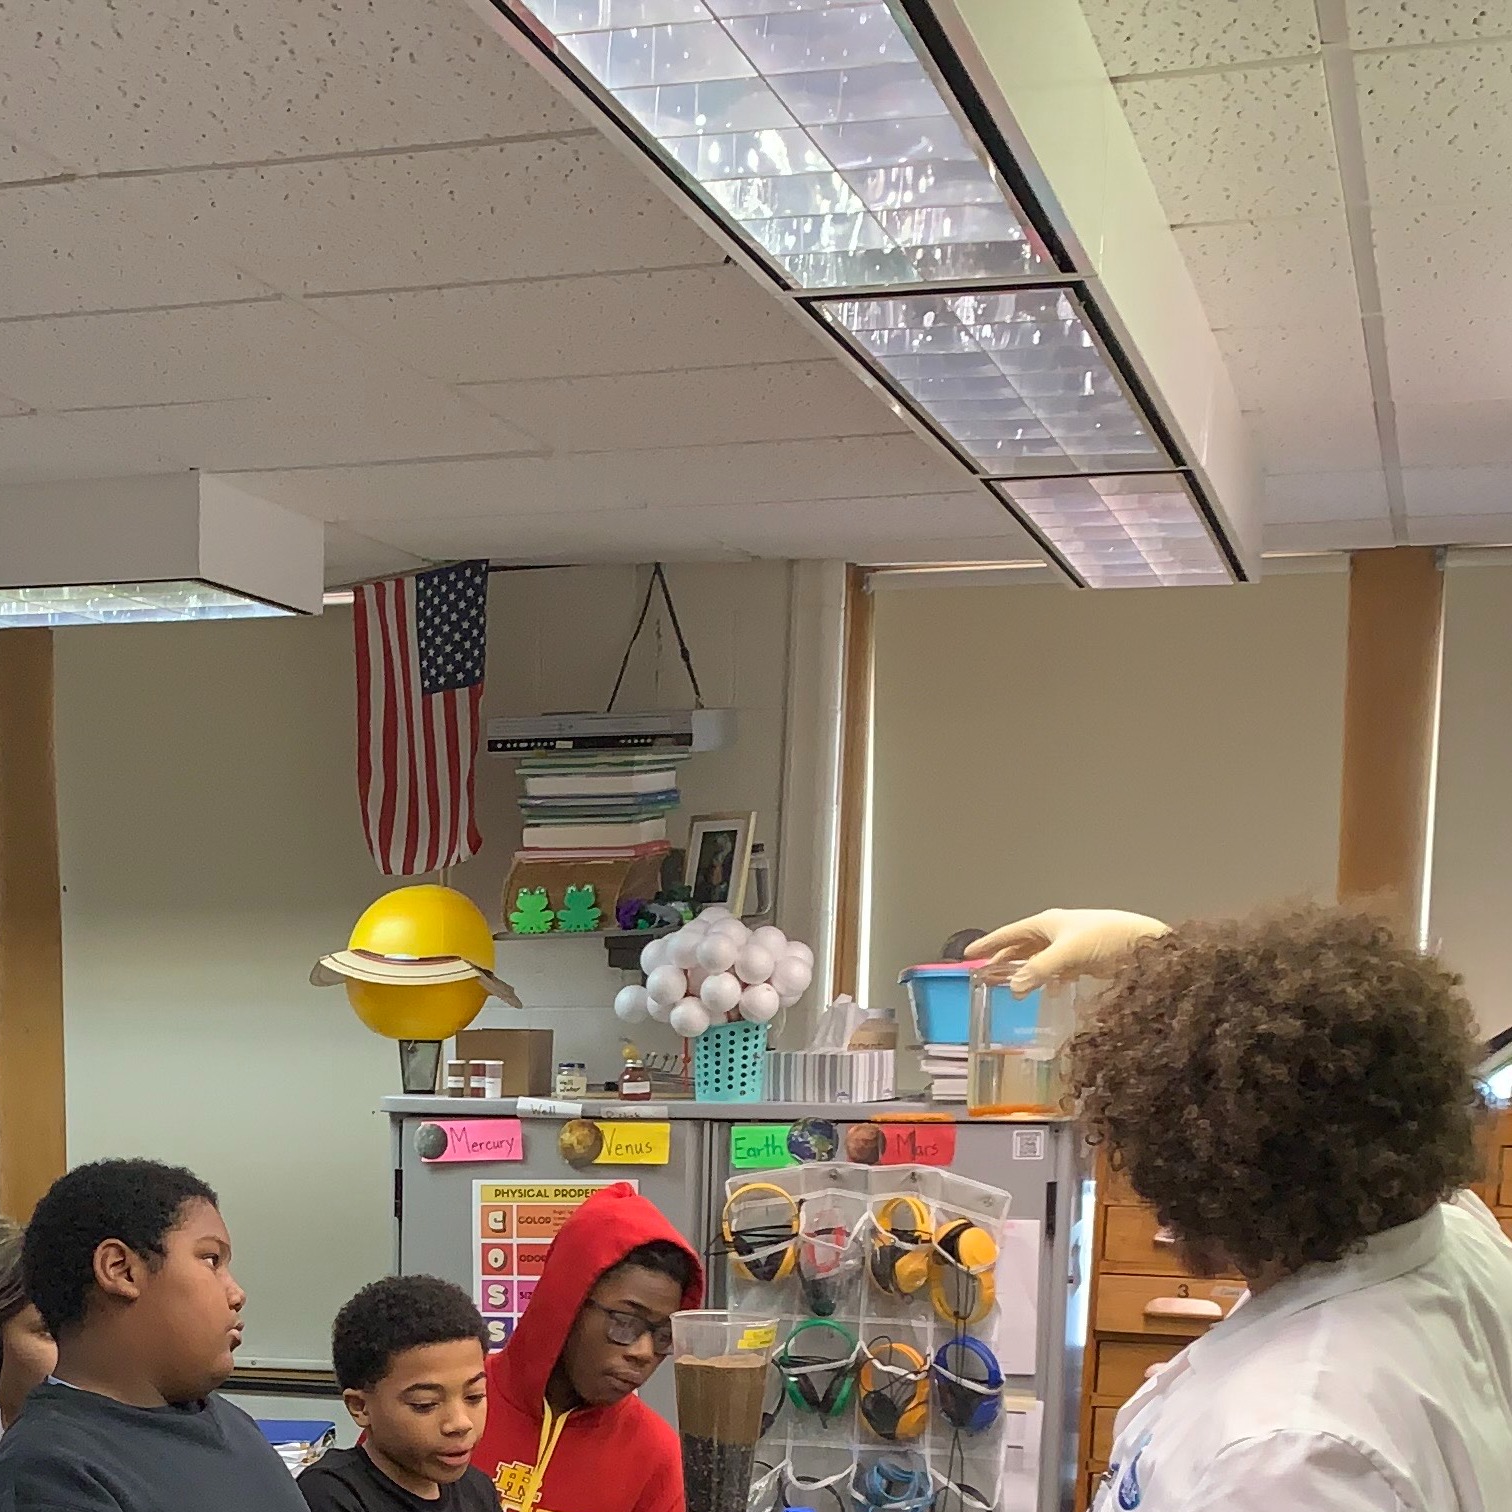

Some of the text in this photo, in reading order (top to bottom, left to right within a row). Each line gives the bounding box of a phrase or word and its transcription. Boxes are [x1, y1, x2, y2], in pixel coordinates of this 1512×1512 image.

[449, 1126, 515, 1158] Mercury
[601, 1127, 653, 1157] Venus
[734, 1134, 784, 1160] Earth
[896, 1126, 939, 1157] Mars
[494, 1188, 550, 1198] PHYSICAL
[1177, 1283, 1190, 1298] 3
